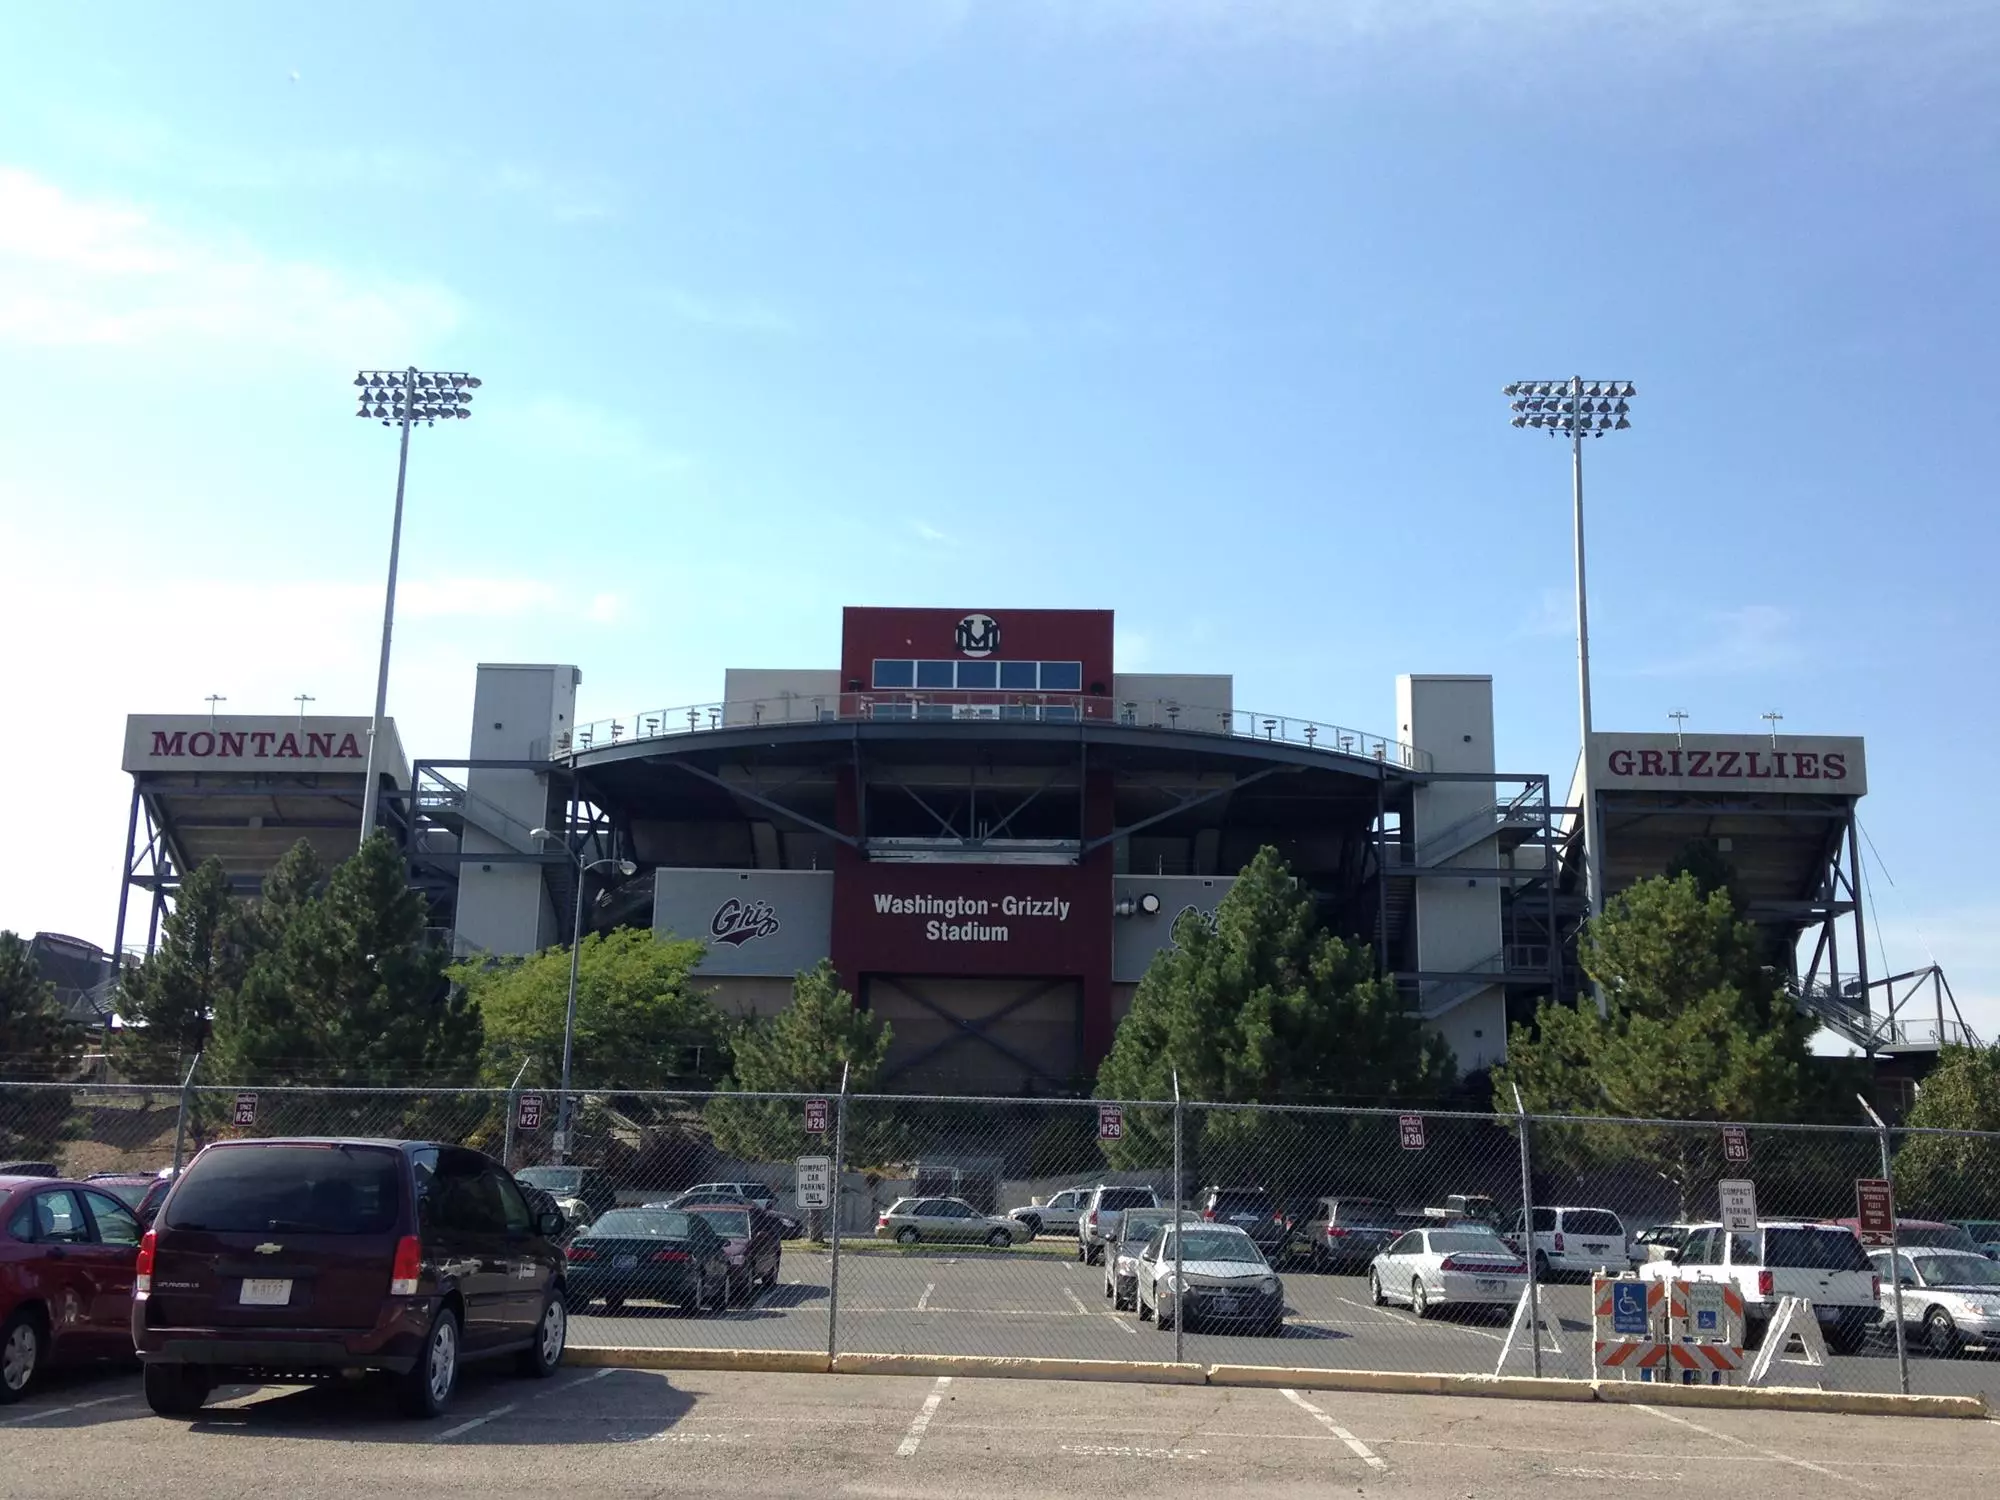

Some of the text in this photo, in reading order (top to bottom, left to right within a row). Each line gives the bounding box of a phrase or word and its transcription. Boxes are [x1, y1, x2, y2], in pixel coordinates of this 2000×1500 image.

[150, 731, 363, 758] MONTANA
[1608, 749, 1847, 780] GRIZZLIES
[711, 897, 780, 938] Griz
[926, 920, 1009, 942] Stadium
[235, 1111, 253, 1122] #26
[521, 1114, 538, 1125] #27
[808, 1118, 825, 1129] #28
[1102, 1124, 1120, 1135] #29
[1404, 1134, 1422, 1145] #30
[1729, 1145, 1745, 1157] #31
[800, 1164, 826, 1172] COMPACT
[800, 1183, 826, 1191] PARKING
[1723, 1187, 1751, 1196] COMPACT
[1731, 1197, 1744, 1205] CAR
[1726, 1207, 1752, 1215] PARKING
[1731, 1216, 1747, 1224] ONLY
